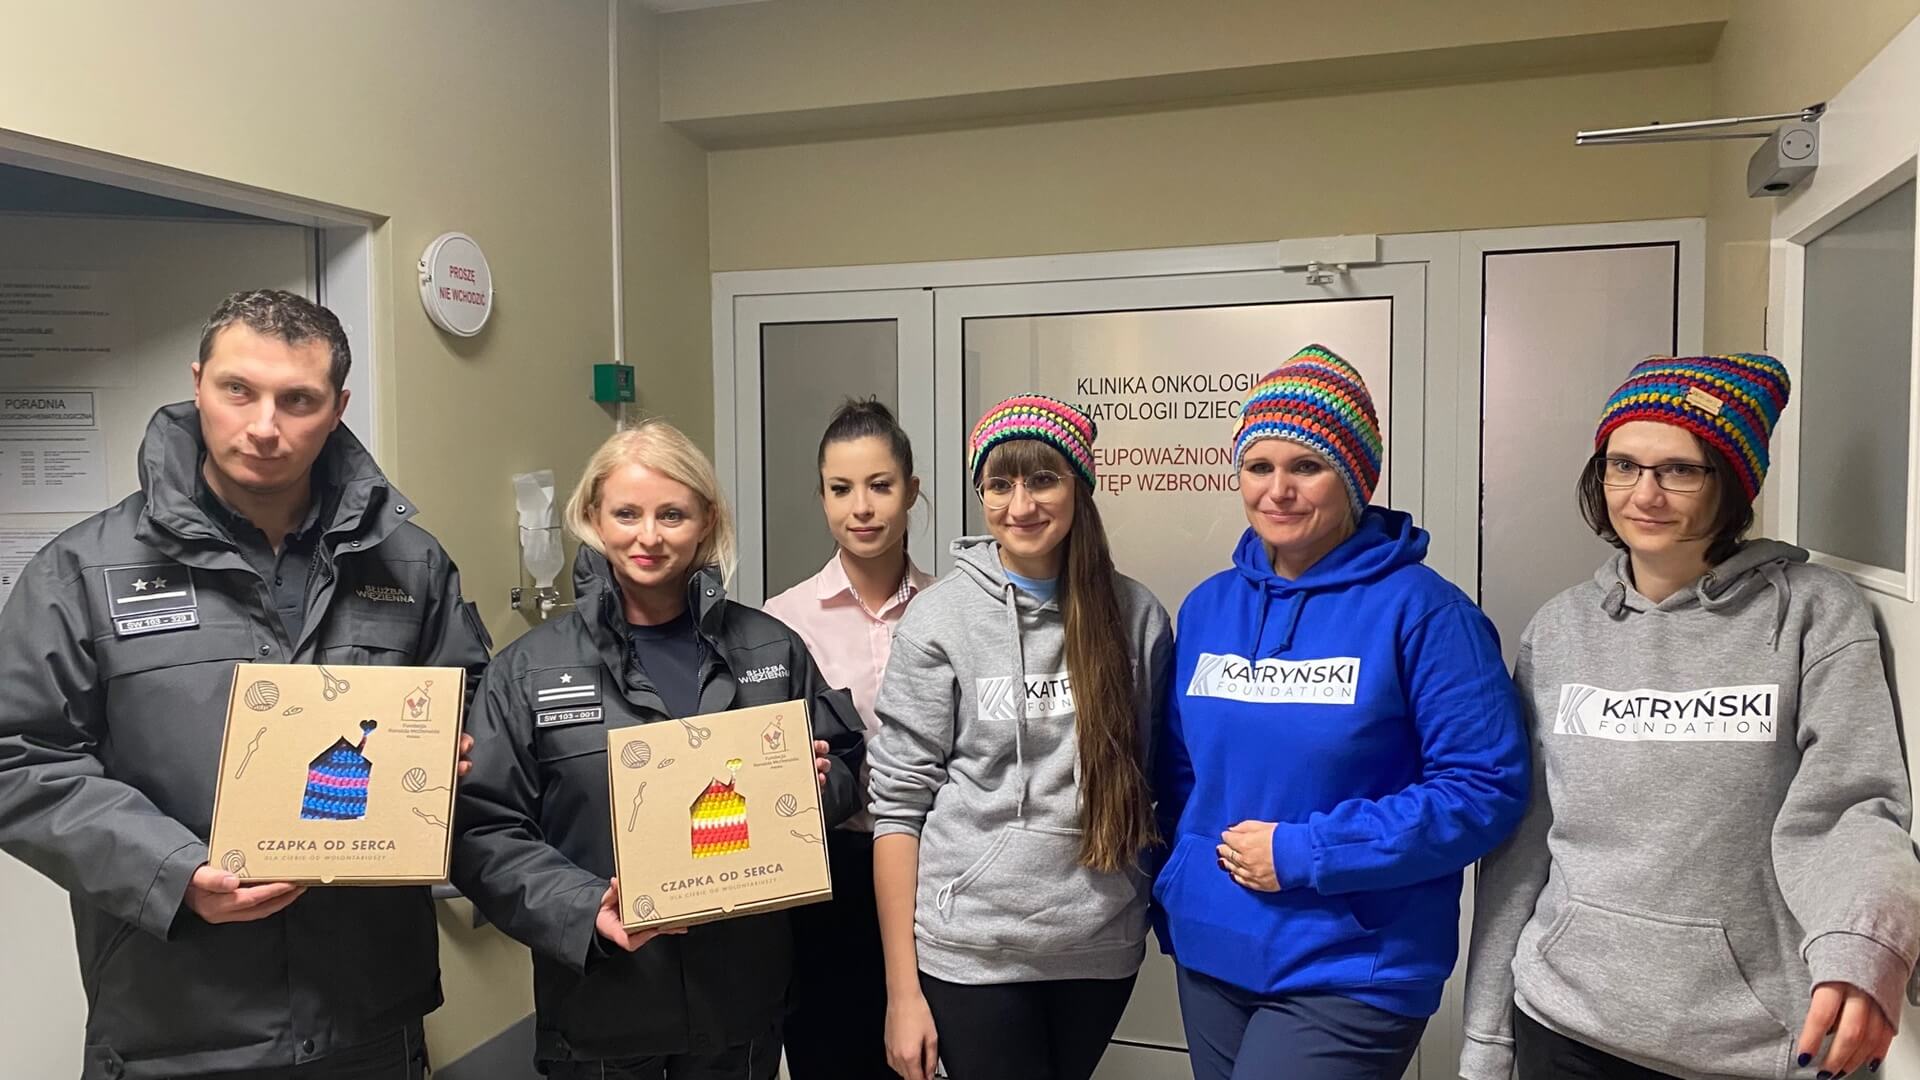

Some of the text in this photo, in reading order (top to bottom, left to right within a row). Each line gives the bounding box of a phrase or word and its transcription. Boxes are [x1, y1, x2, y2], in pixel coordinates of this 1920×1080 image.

[449, 265, 476, 286] PROSZĘ
[439, 287, 451, 300] NIE
[1077, 373, 1259, 396] KLINIKA ONKOLOGII
[4, 399, 66, 410] PORADNIA
[1184, 400, 1241, 419] DZIEC
[1092, 443, 1232, 466] EUPOWAŻNION
[1096, 473, 1241, 496] TĘP WZBRONIO
[126, 621, 143, 630] SW
[1221, 661, 1354, 685] KATRYŃSKI
[1216, 681, 1352, 697] FOUNDATION
[1027, 698, 1071, 712] FOUN
[1602, 690, 1772, 719] KATRYŃSKI
[558, 712, 573, 720] 103
[1599, 720, 1773, 734] FOUNDATION
[257, 840, 396, 851] CZAPKA OD SERCA
[660, 863, 784, 893] CZAPKA OD SERCA
